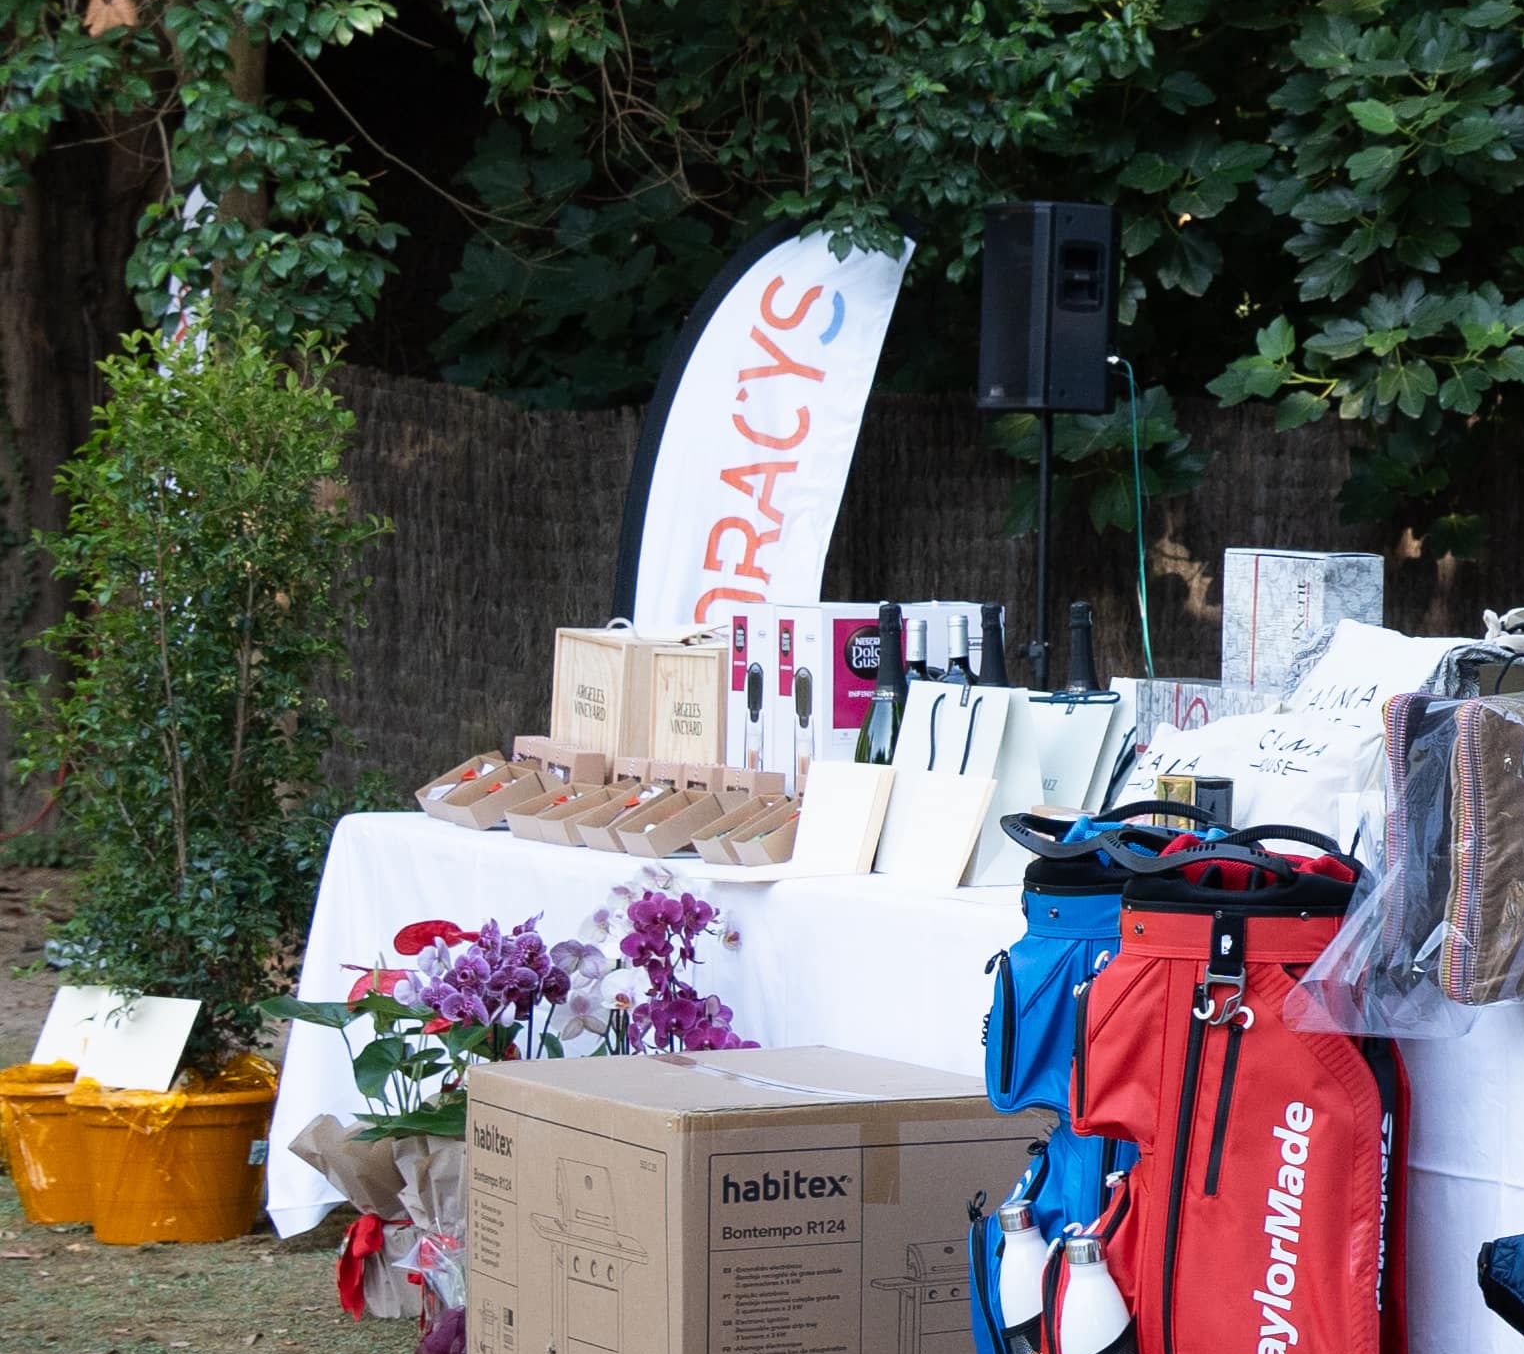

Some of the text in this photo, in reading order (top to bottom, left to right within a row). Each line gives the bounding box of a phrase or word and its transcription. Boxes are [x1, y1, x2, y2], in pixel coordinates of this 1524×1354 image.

[574, 701, 607, 722] VINEYARD
[670, 718, 703, 736] VINEYARD
[473, 1120, 513, 1158] habitex
[473, 1167, 499, 1190] Bontempo
[721, 1168, 848, 1205] habitex
[721, 1218, 846, 1241] Bontempo R124
